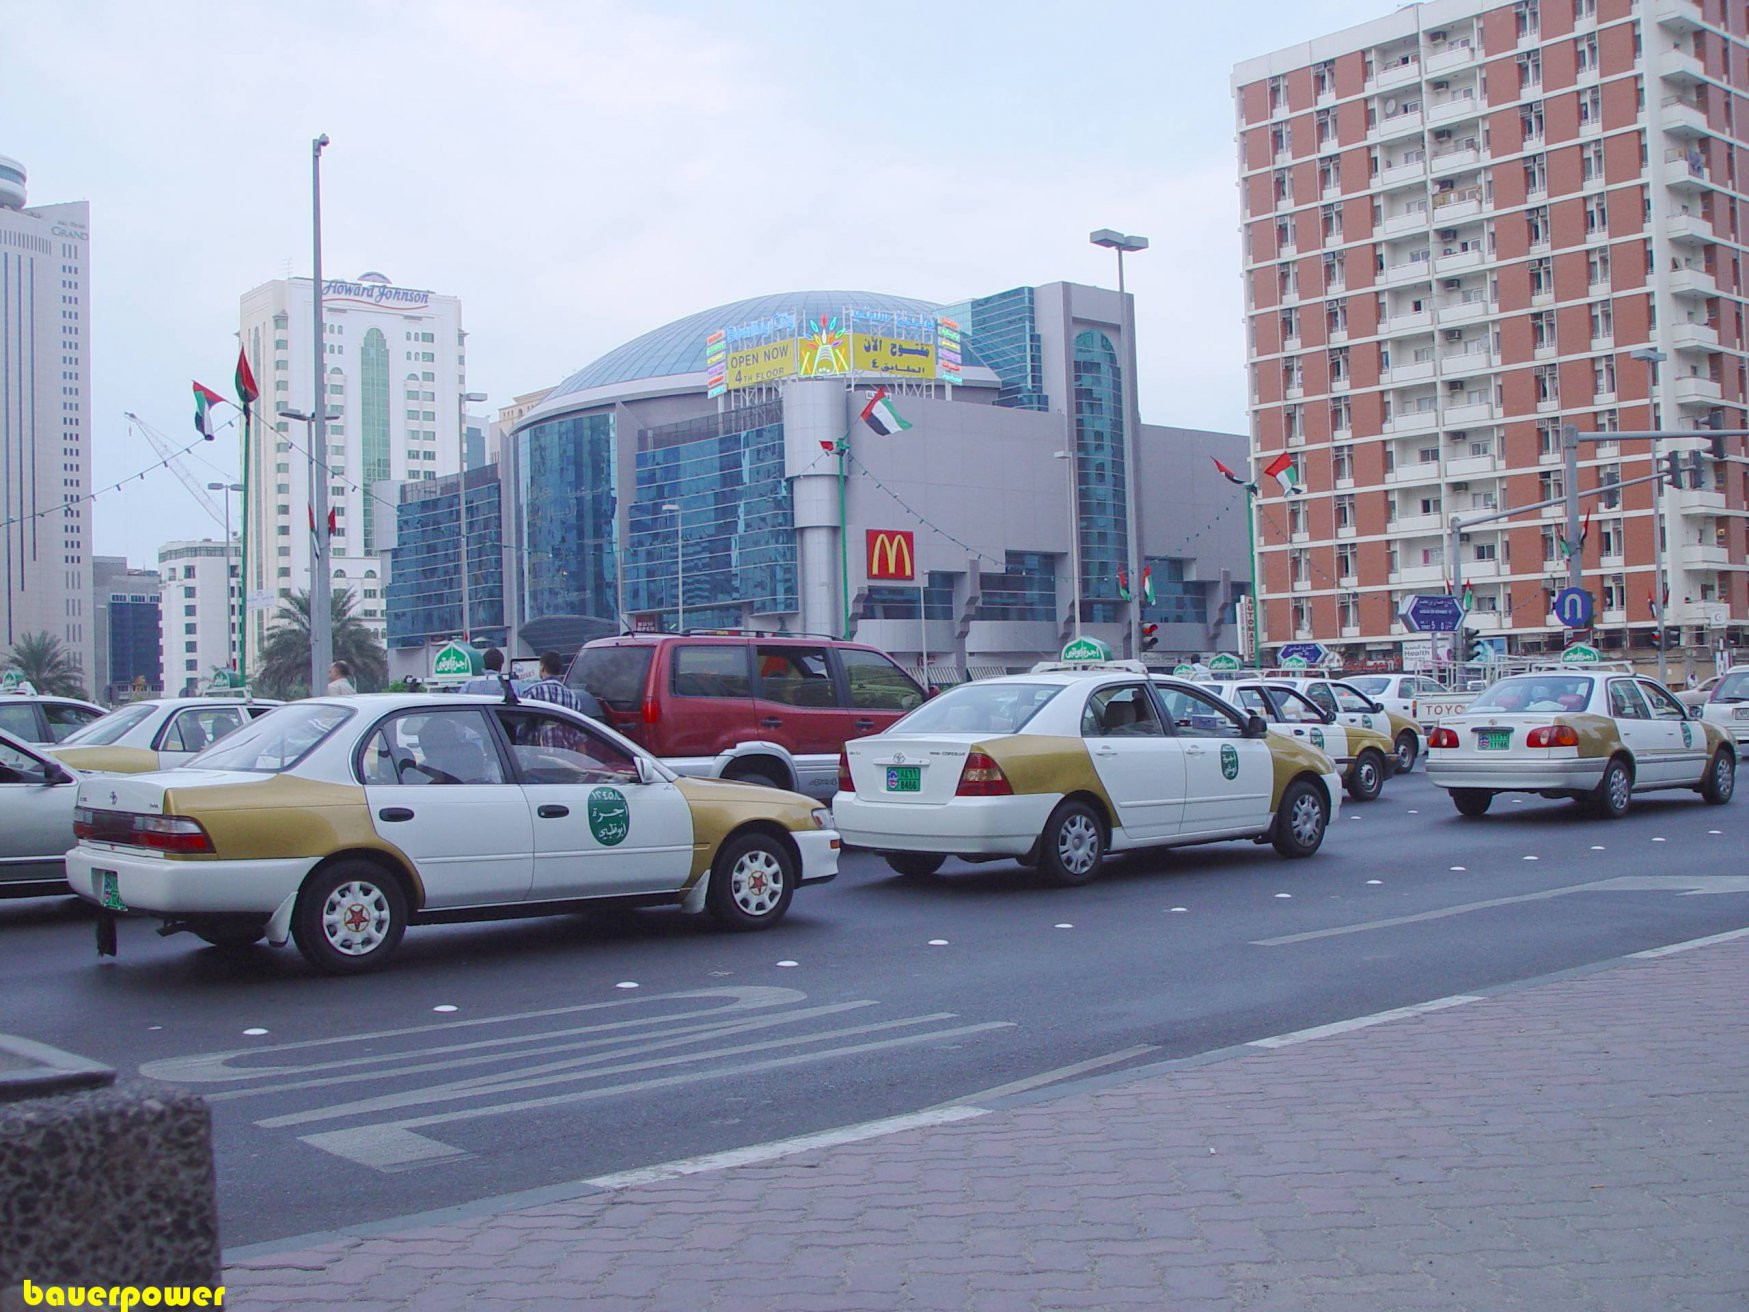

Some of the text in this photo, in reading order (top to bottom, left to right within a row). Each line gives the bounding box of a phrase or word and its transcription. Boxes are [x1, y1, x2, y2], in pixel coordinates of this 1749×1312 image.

[322, 280, 429, 305] Howard Johnson
[730, 345, 789, 369] OPEN NOW
[756, 367, 785, 381] FLOOR
[1247, 598, 1255, 660] AUTOMATIC
